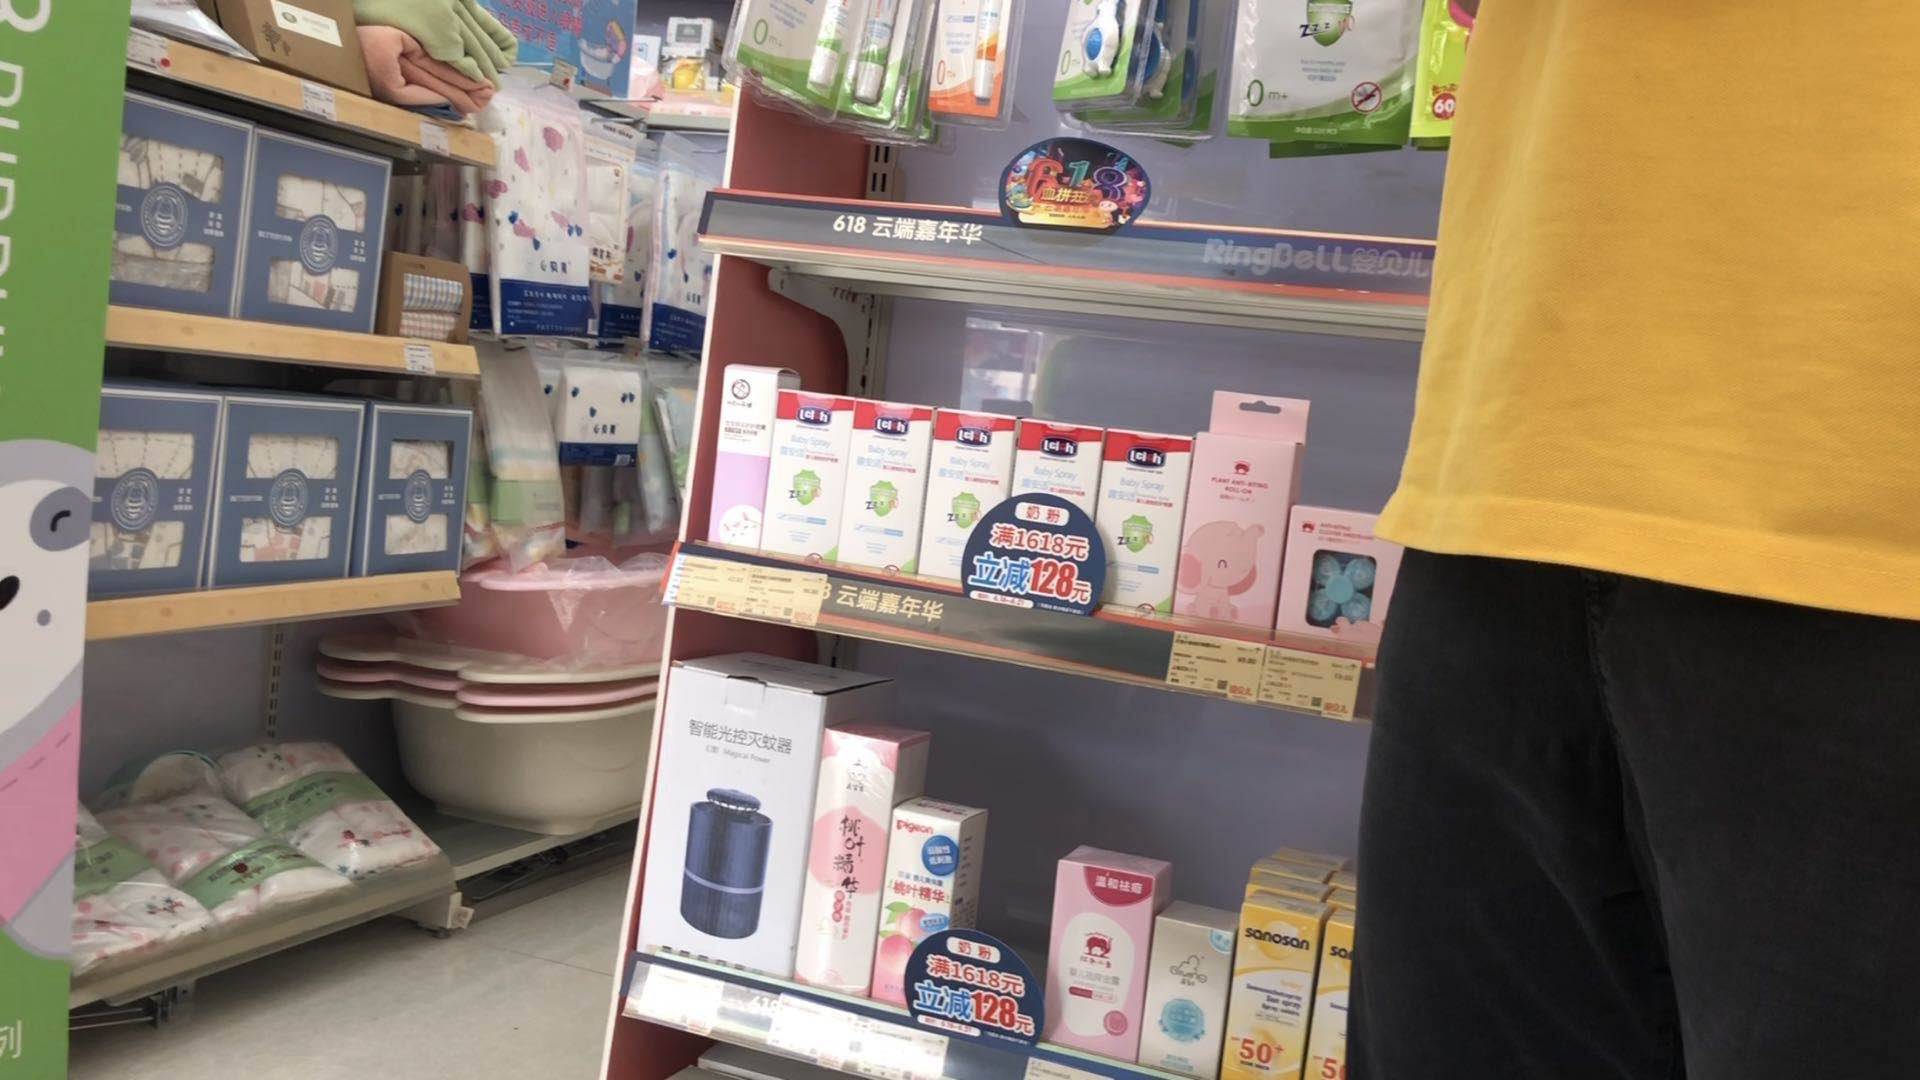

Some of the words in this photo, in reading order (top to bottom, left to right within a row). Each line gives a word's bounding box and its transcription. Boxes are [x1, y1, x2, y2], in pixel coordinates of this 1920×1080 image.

[833, 215, 866, 235] 618
[872, 217, 983, 245] 云端嘉年华
[1026, 505, 1060, 523] 奶粉
[990, 524, 1088, 560] 满1618元
[969, 553, 1091, 603] 立减128元
[837, 583, 944, 622] 云端嘉年华
[688, 718, 792, 755] 智能光控灭蚊器
[958, 940, 992, 960] 奶粉
[1245, 926, 1310, 951] sanosan
[928, 954, 1025, 996] 满1618元
[914, 980, 1035, 1035] 立减128元
[1239, 1038, 1284, 1064] 50+
